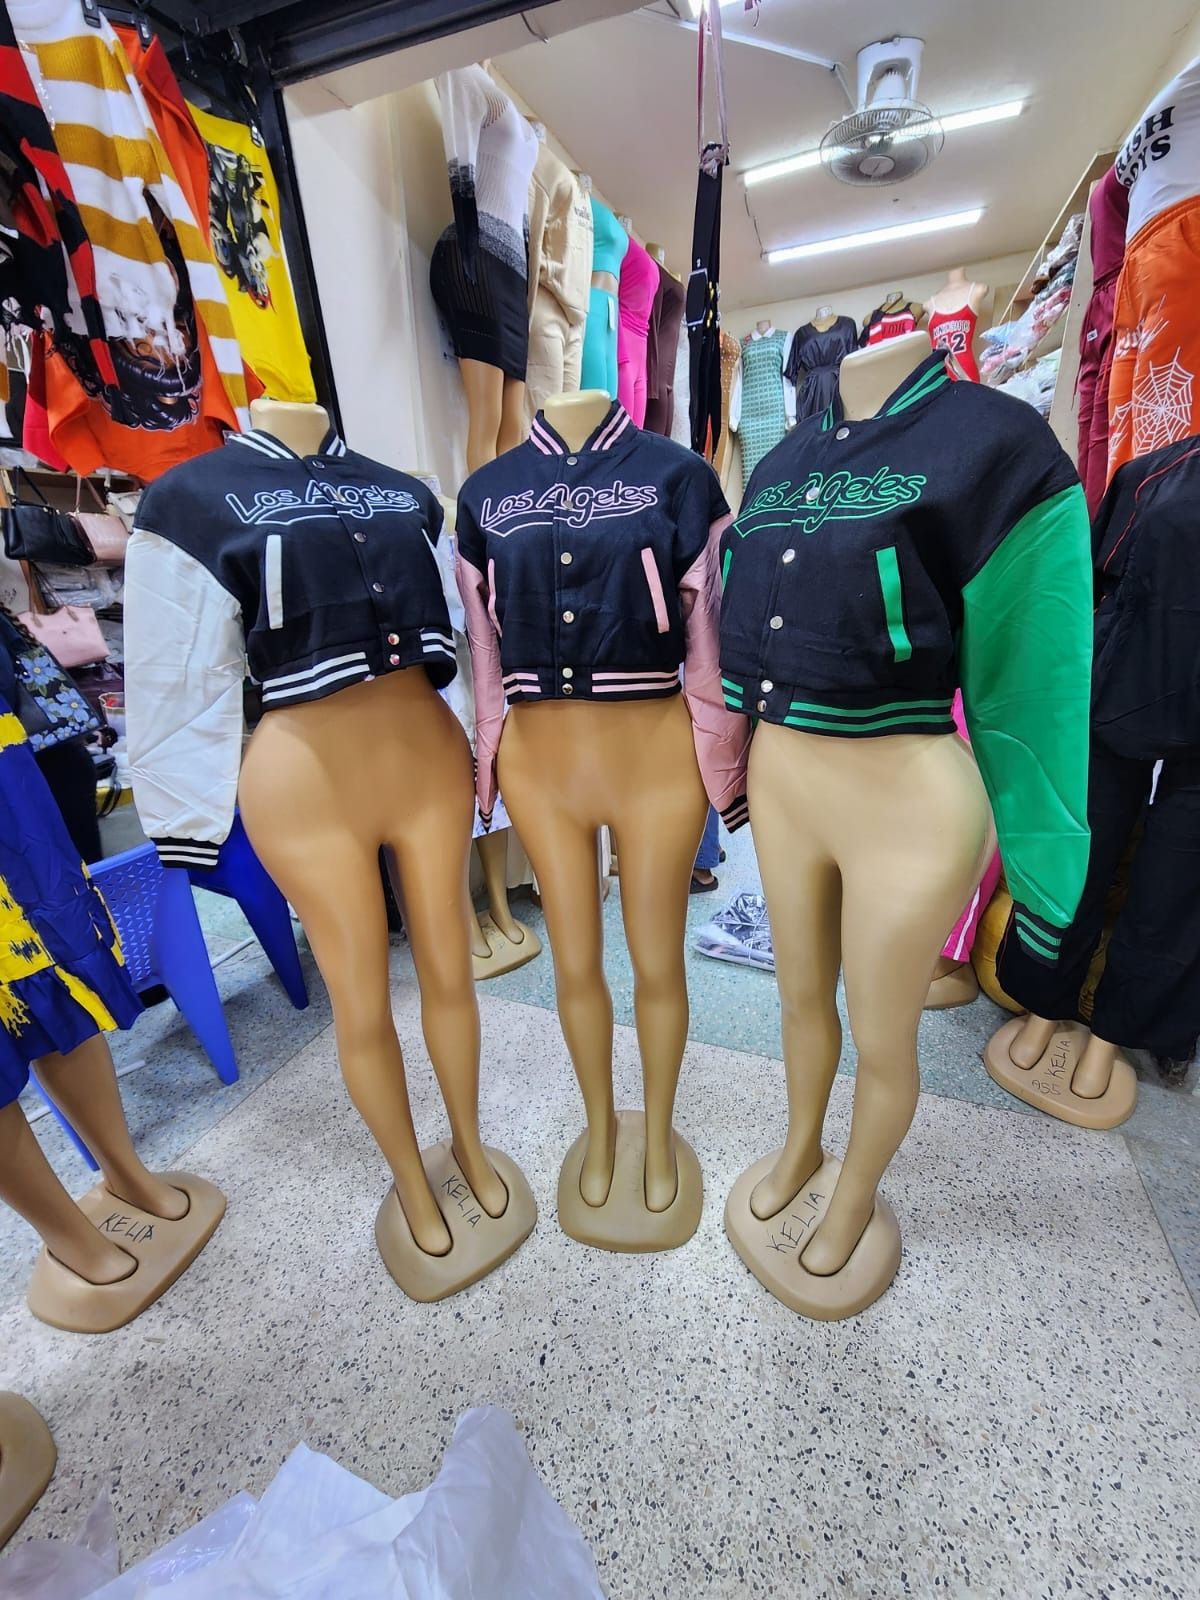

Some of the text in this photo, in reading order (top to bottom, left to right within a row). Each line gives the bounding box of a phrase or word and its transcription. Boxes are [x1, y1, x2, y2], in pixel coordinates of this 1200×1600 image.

[225, 489, 302, 524] Los
[480, 489, 535, 528] Los
[1044, 1039, 1072, 1080] KELIA
[441, 1174, 482, 1229] KELIA
[97, 1212, 155, 1244] KELIA
[764, 1191, 826, 1254] KELIA
